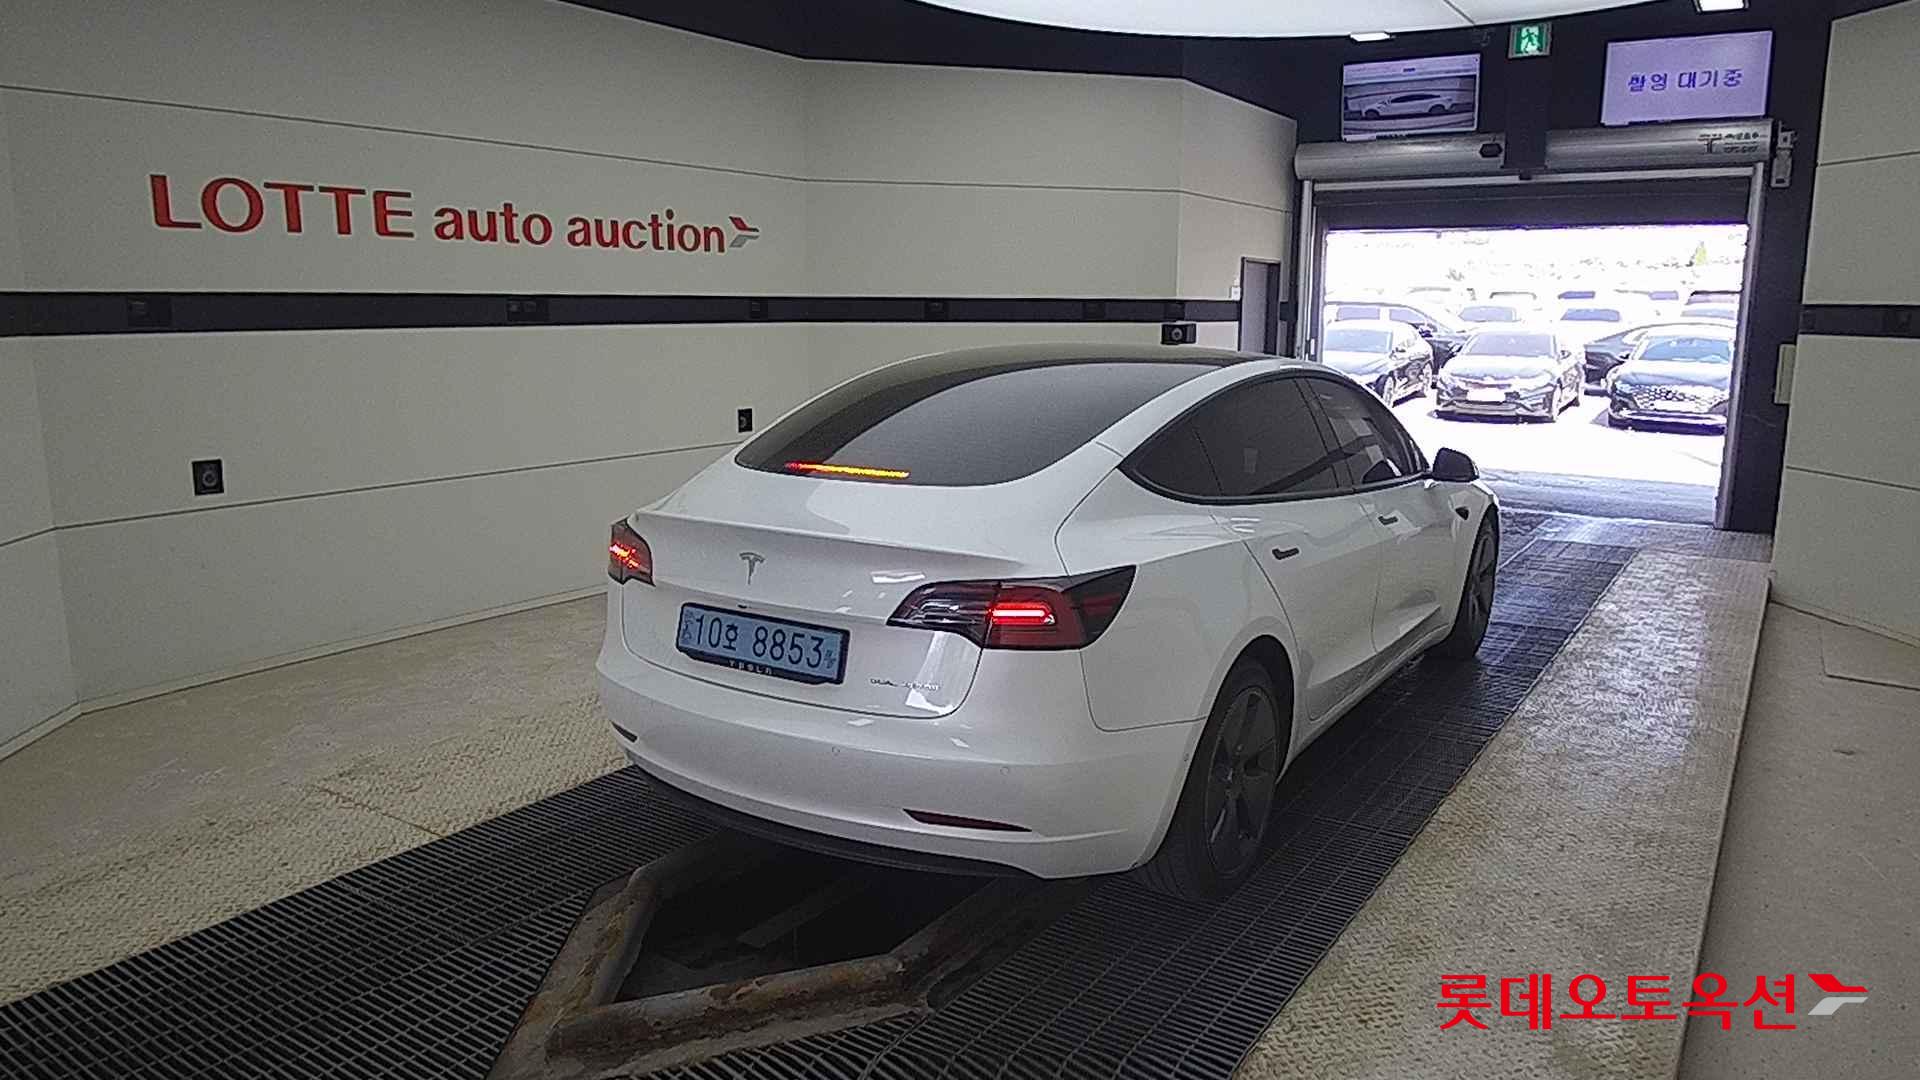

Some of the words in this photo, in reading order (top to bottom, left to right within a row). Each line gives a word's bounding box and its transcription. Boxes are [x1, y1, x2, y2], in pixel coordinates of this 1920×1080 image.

[1678, 69, 1742, 88] 대기중
[149, 174, 414, 238] LOTTE
[433, 203, 553, 246] auto
[566, 207, 726, 254] auction
[696, 614, 739, 651] 10호
[752, 626, 825, 668] 8853
